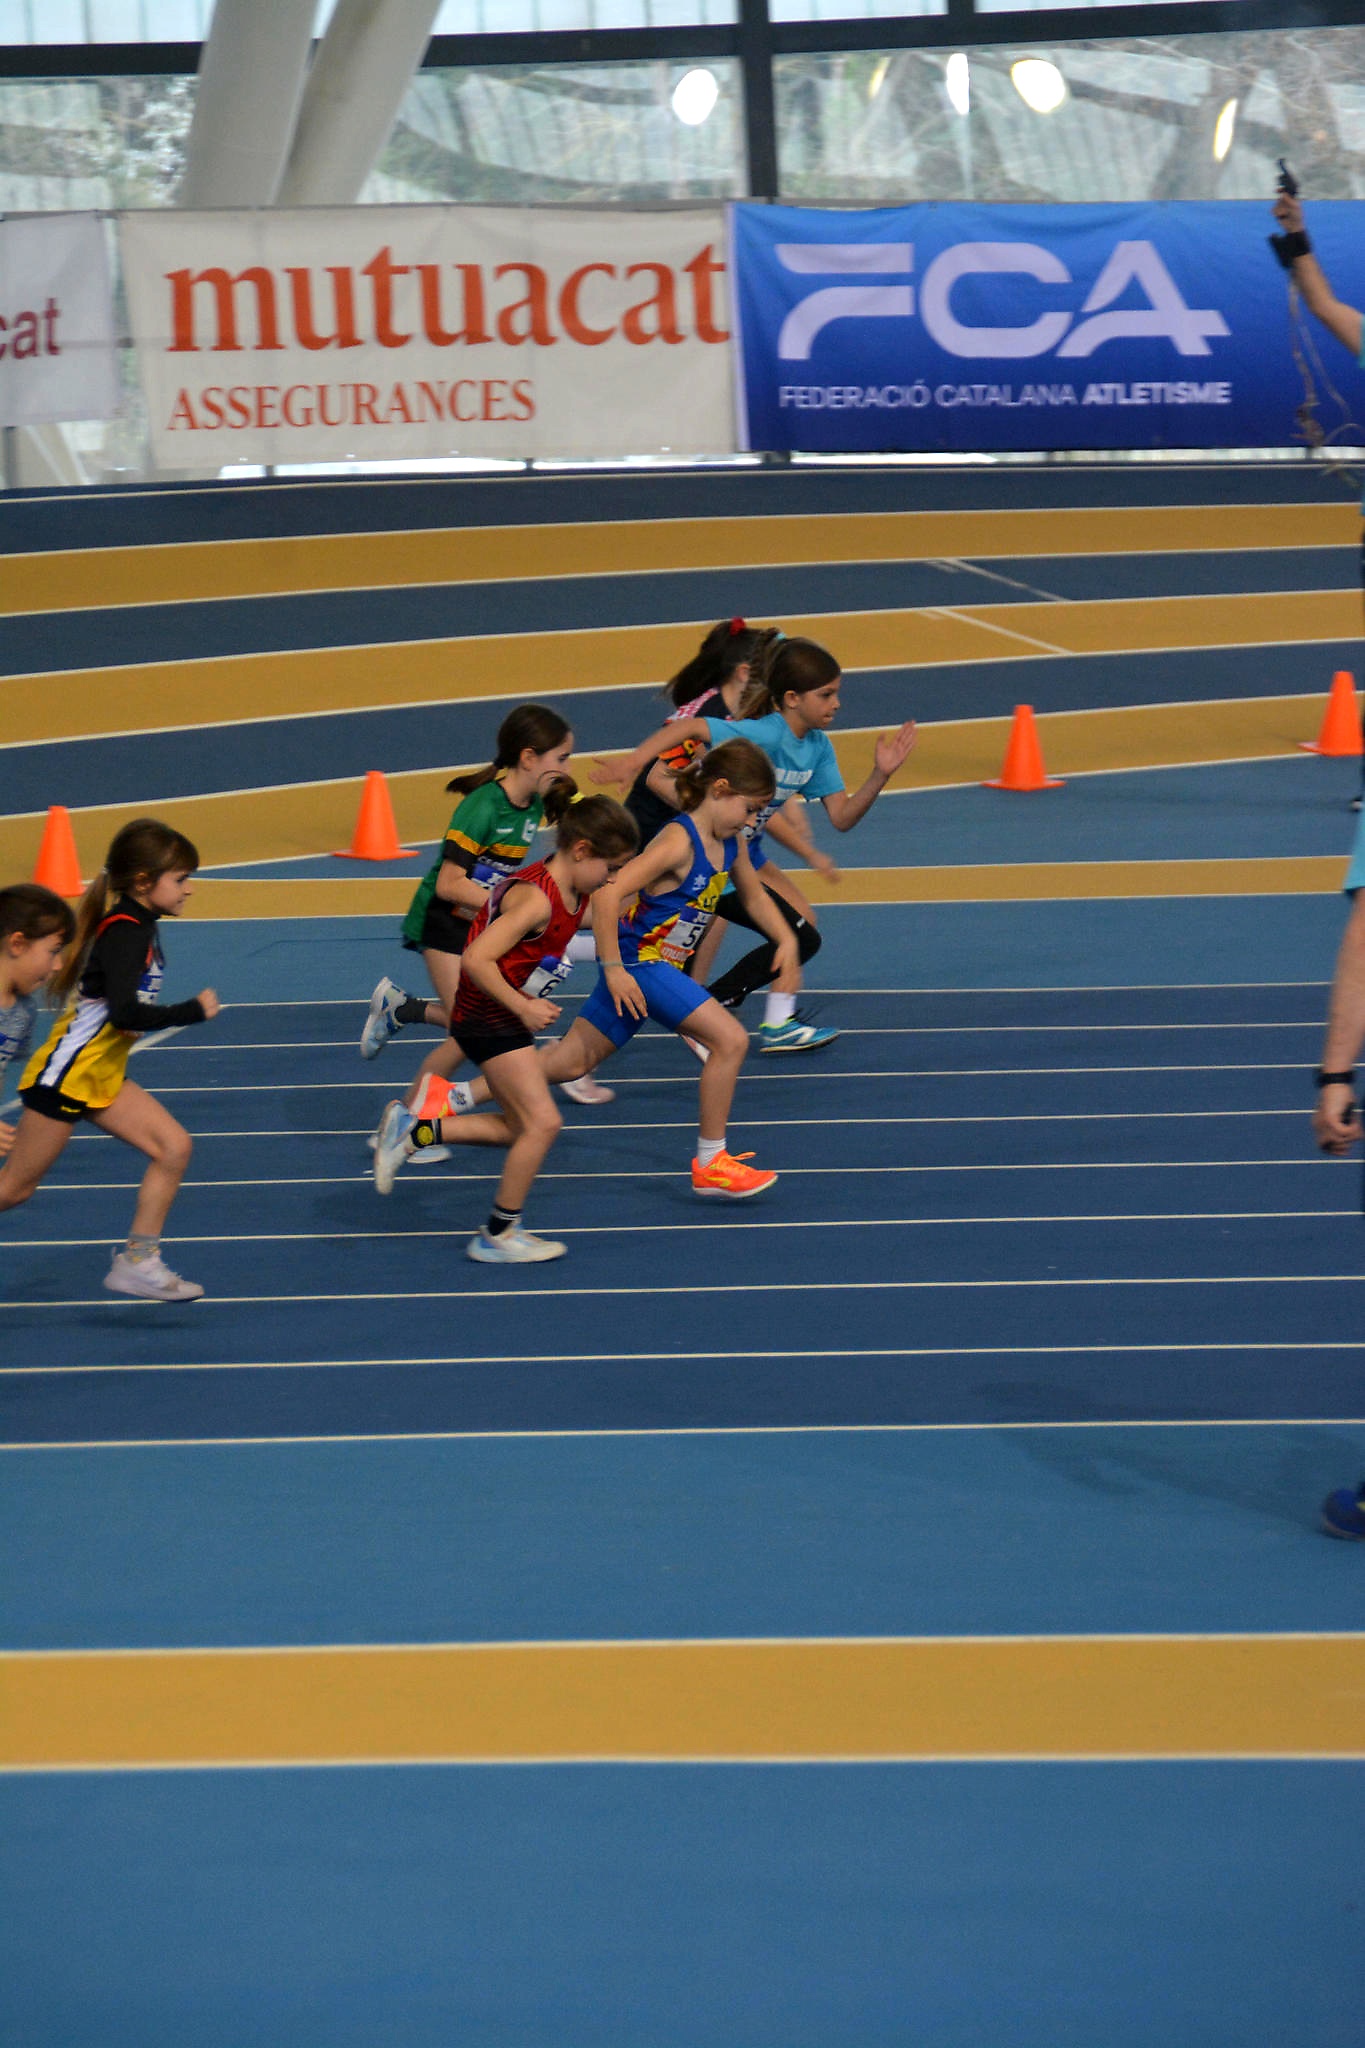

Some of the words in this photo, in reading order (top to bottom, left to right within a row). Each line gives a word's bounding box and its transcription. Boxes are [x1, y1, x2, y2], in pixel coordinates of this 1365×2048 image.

[165, 244, 730, 352] mutuacat
[774, 240, 1231, 359] FCA
[168, 378, 535, 431] ASSEGURANCES
[779, 377, 929, 409] FEDERACIÓ
[934, 383, 1077, 408] CATALANA
[1082, 381, 1231, 406] ATLETISME
